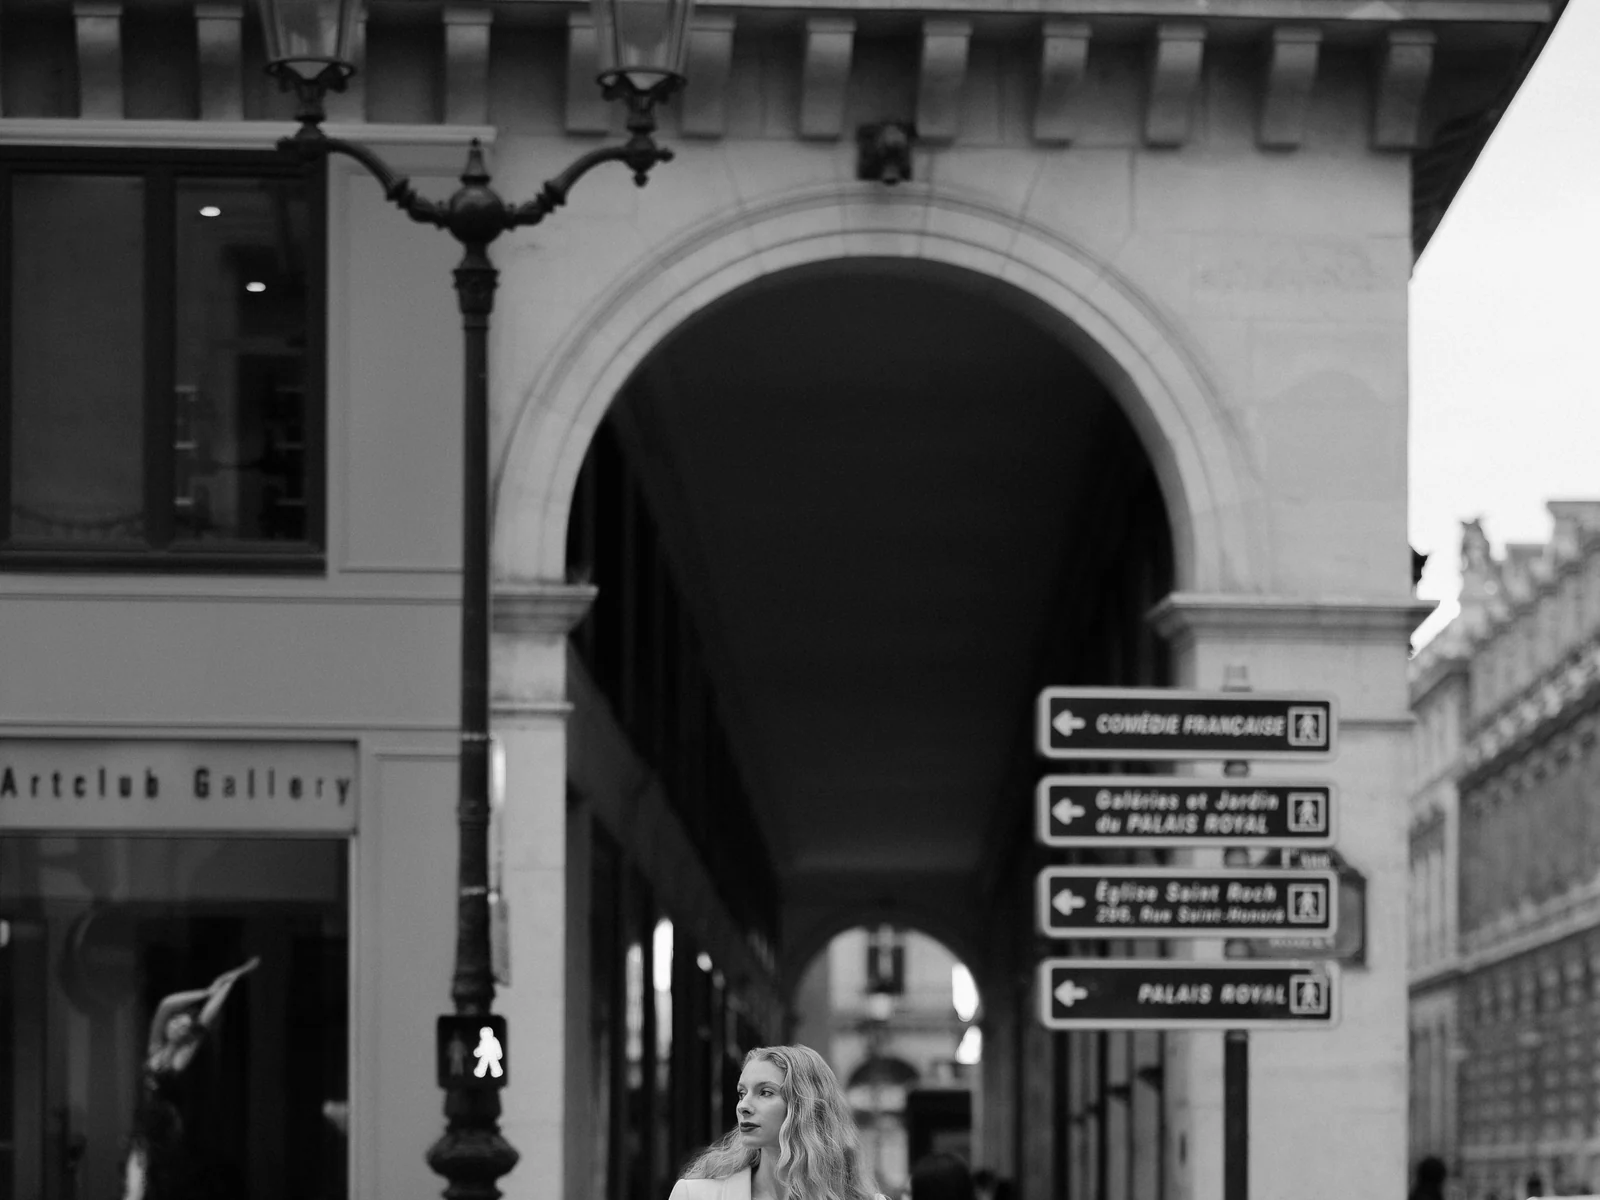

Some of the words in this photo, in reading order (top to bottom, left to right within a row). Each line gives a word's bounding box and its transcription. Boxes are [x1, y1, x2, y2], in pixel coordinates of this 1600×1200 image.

[1095, 711, 1180, 735] COMÉDIE
[193, 765, 351, 806] Gallery
[1186, 792, 1208, 811] et
[1214, 789, 1280, 811] Jardin
[1095, 813, 1122, 834] du
[1126, 813, 1199, 834] PALAIS
[1203, 813, 1269, 834] ROYAL
[1165, 881, 1220, 902] Saint
[1226, 881, 1277, 902] Roch
[1137, 983, 1213, 1005] PALAIS
[1220, 983, 1287, 1005] ROYAL
